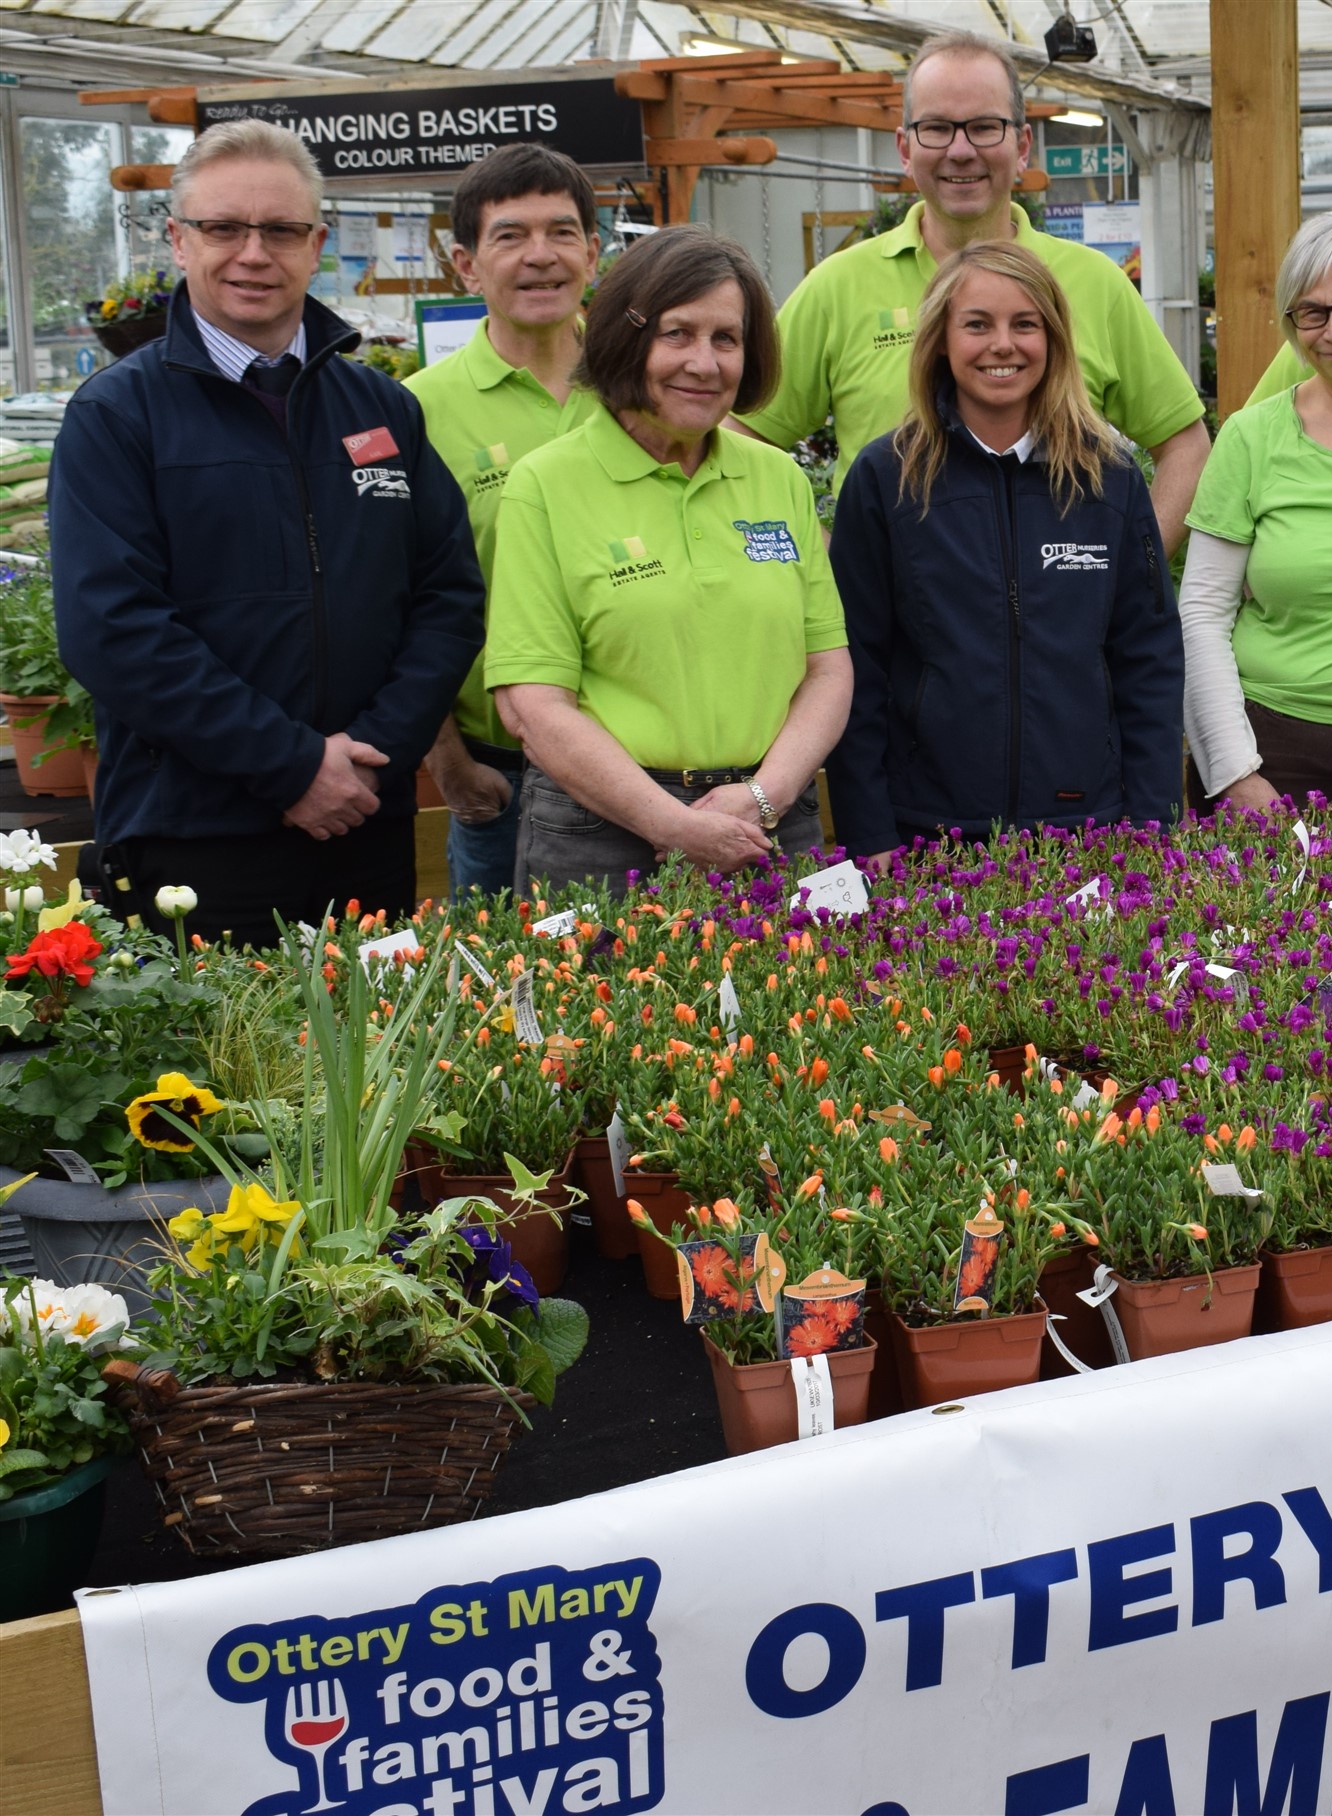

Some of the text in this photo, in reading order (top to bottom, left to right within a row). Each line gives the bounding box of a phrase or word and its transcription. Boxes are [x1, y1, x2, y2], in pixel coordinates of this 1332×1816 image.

[419, 103, 558, 139] BASKETS
[334, 143, 498, 169] COLOUR THEMED
[1053, 157, 1072, 167] Exit
[352, 467, 390, 484] OTTER
[753, 530, 789, 541] food &
[746, 547, 797, 561] festival
[751, 541, 793, 550] families
[1041, 543, 1077, 558] OTTER
[609, 559, 664, 581] Hall & Scott
[227, 1575, 643, 1684] Ottery St Mary
[377, 1629, 637, 1726] food &
[339, 1689, 653, 1793] families
